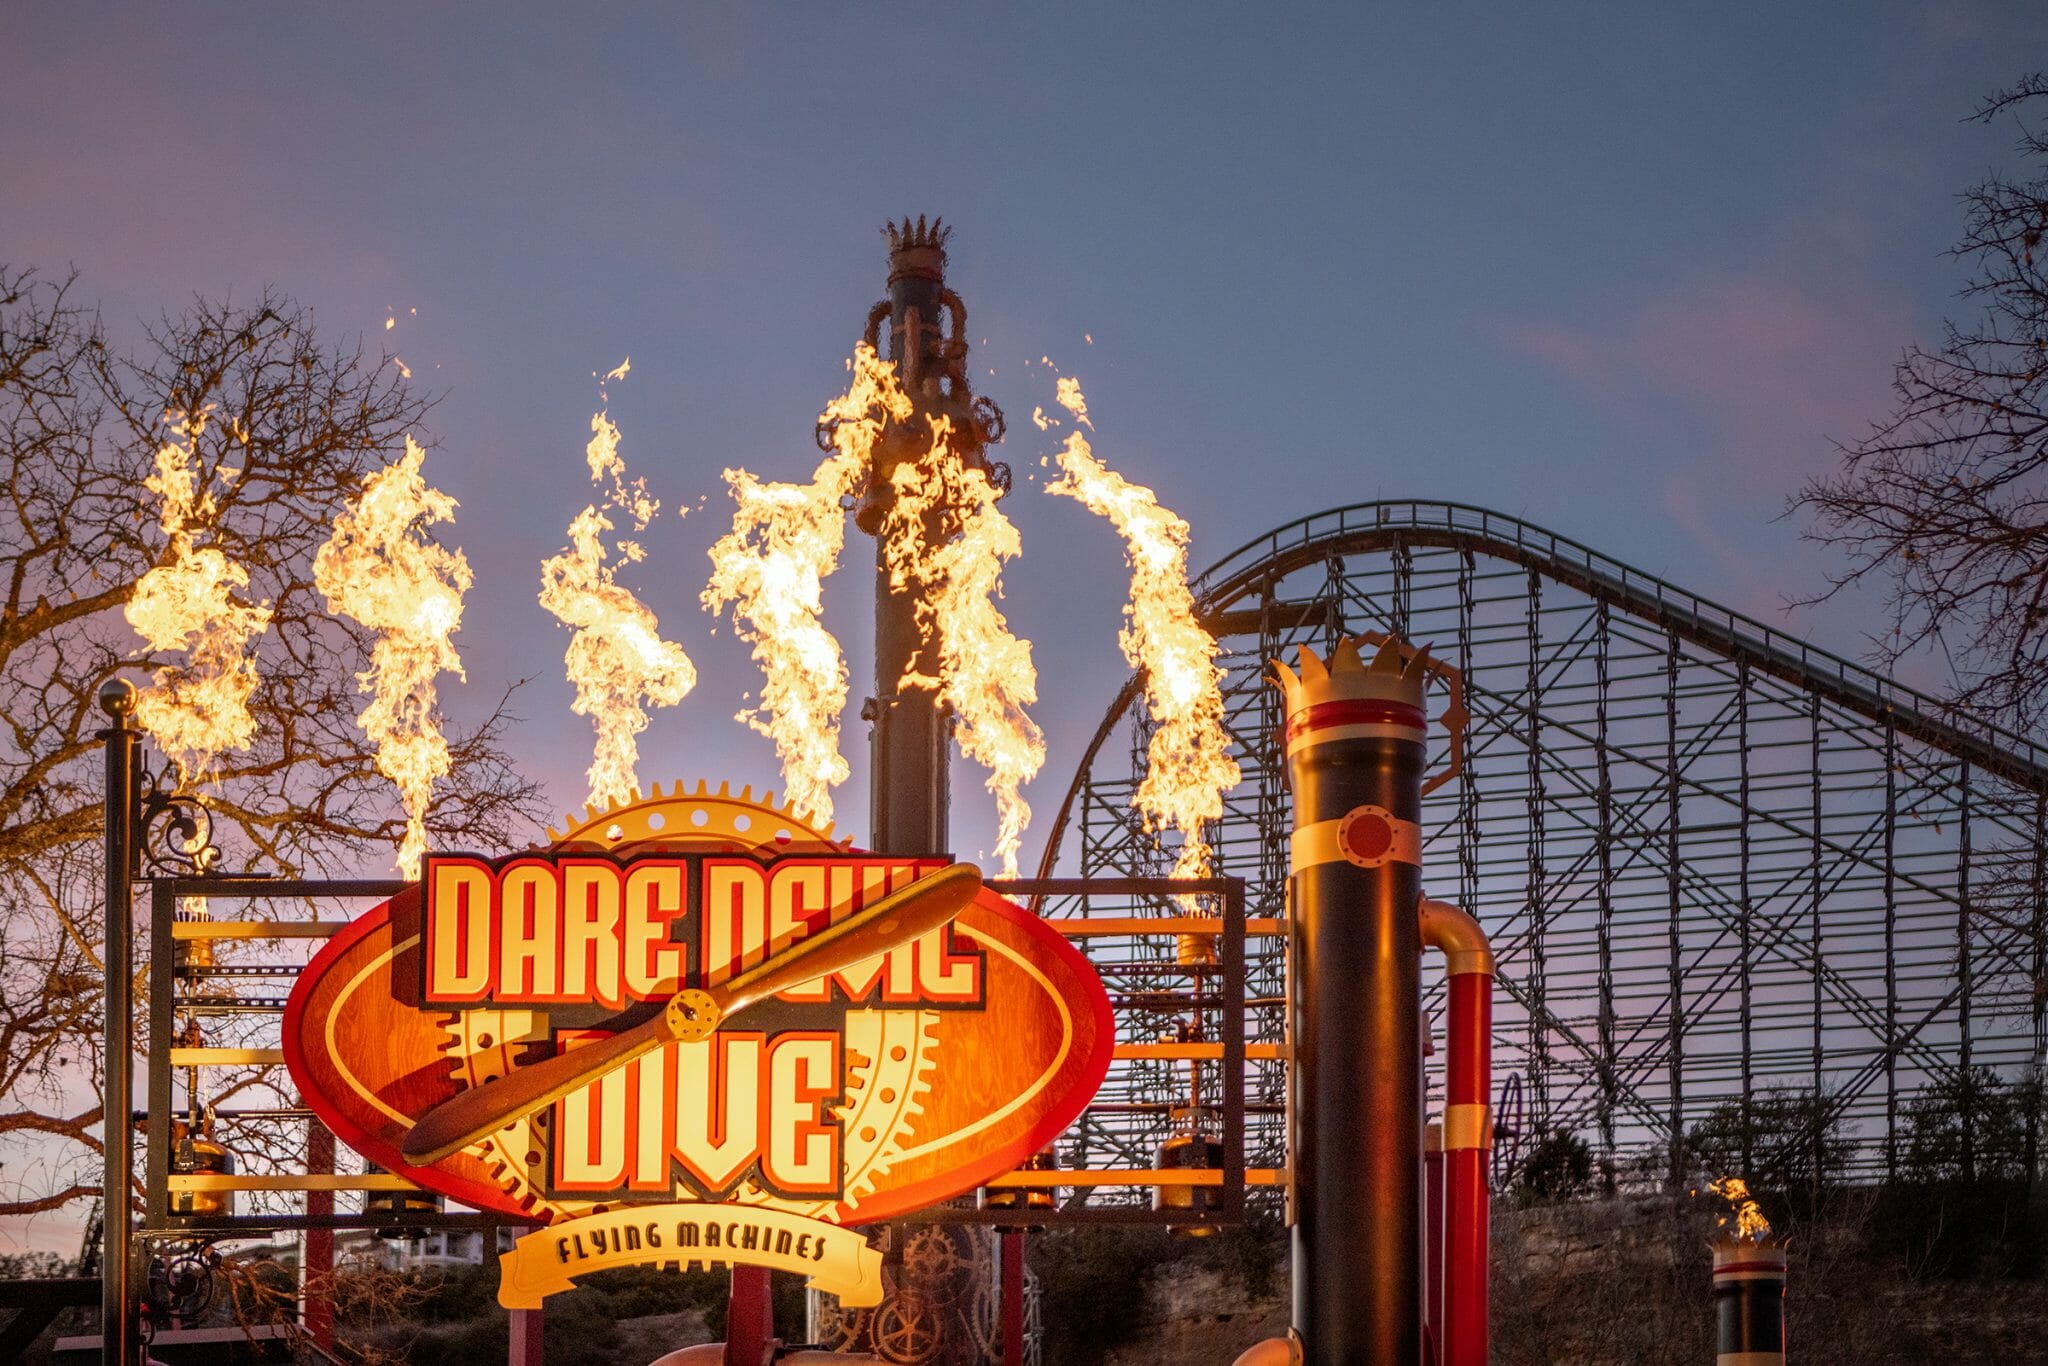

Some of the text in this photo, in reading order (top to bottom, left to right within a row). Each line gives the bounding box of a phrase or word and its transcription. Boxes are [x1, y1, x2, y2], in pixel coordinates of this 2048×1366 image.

[430, 862, 689, 1000] DARE
[560, 1035, 834, 1185] DIVE
[556, 1220, 827, 1264] FLYING MACHINES
